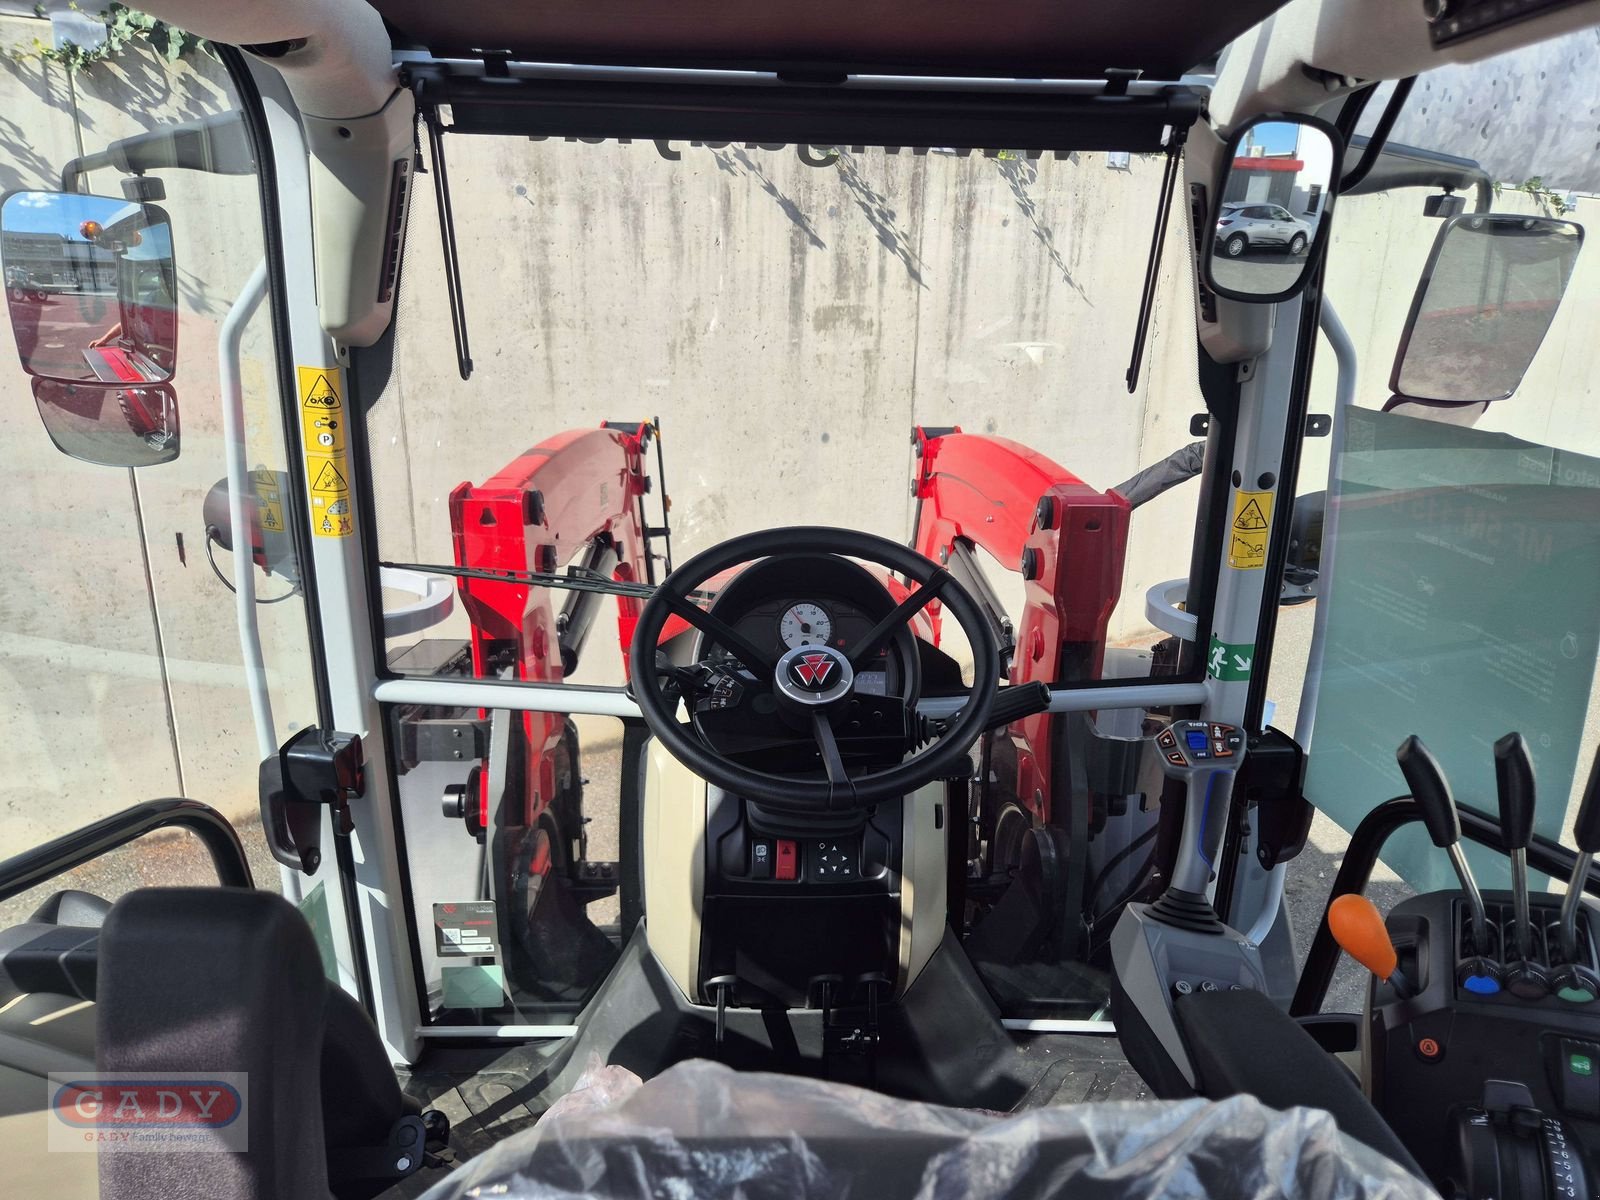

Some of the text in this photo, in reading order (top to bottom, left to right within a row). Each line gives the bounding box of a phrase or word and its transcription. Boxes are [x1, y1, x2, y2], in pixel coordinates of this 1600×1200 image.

[323, 435, 330, 443] P
[1561, 1151, 1569, 1159] 6
[1563, 1161, 1571, 1170] 5
[1565, 1174, 1573, 1183] 4
[1567, 1186, 1575, 1197] 3
